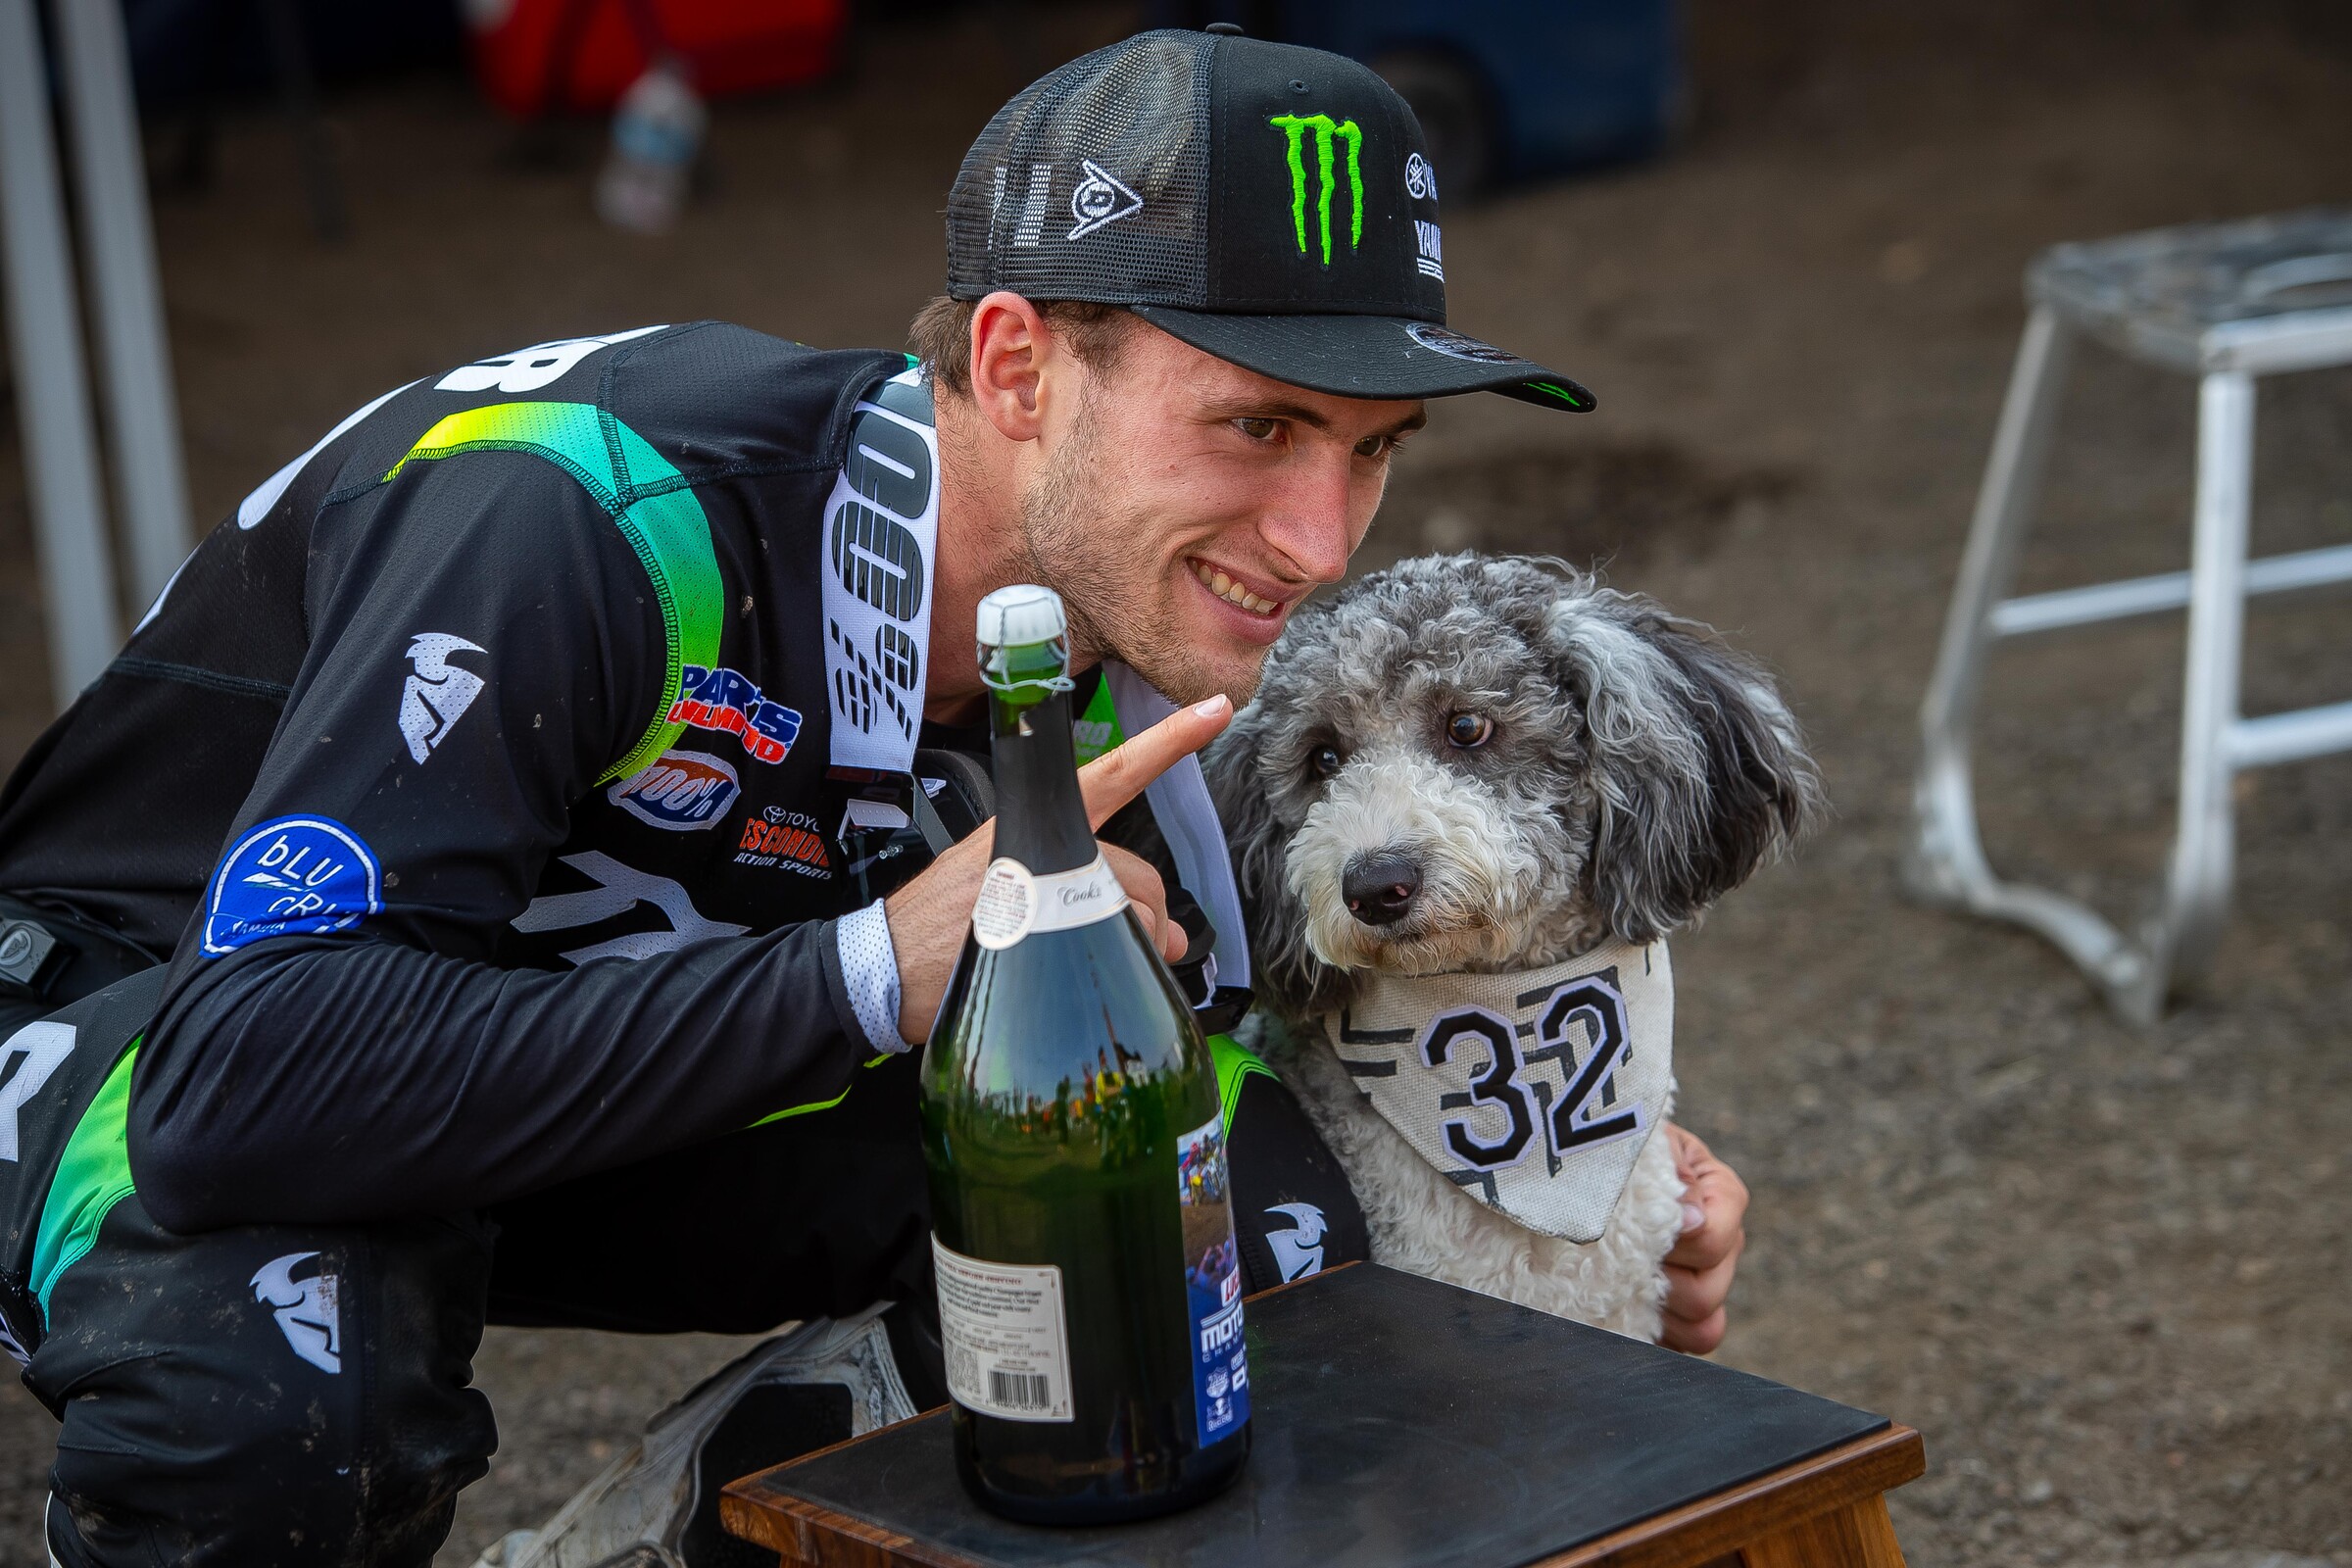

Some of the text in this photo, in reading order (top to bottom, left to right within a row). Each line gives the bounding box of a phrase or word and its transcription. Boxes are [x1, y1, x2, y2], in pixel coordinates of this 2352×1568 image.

[677, 663, 803, 744] PARS
[733, 853, 832, 880] ACTION SPORTS
[1418, 976, 1646, 1173] 32
